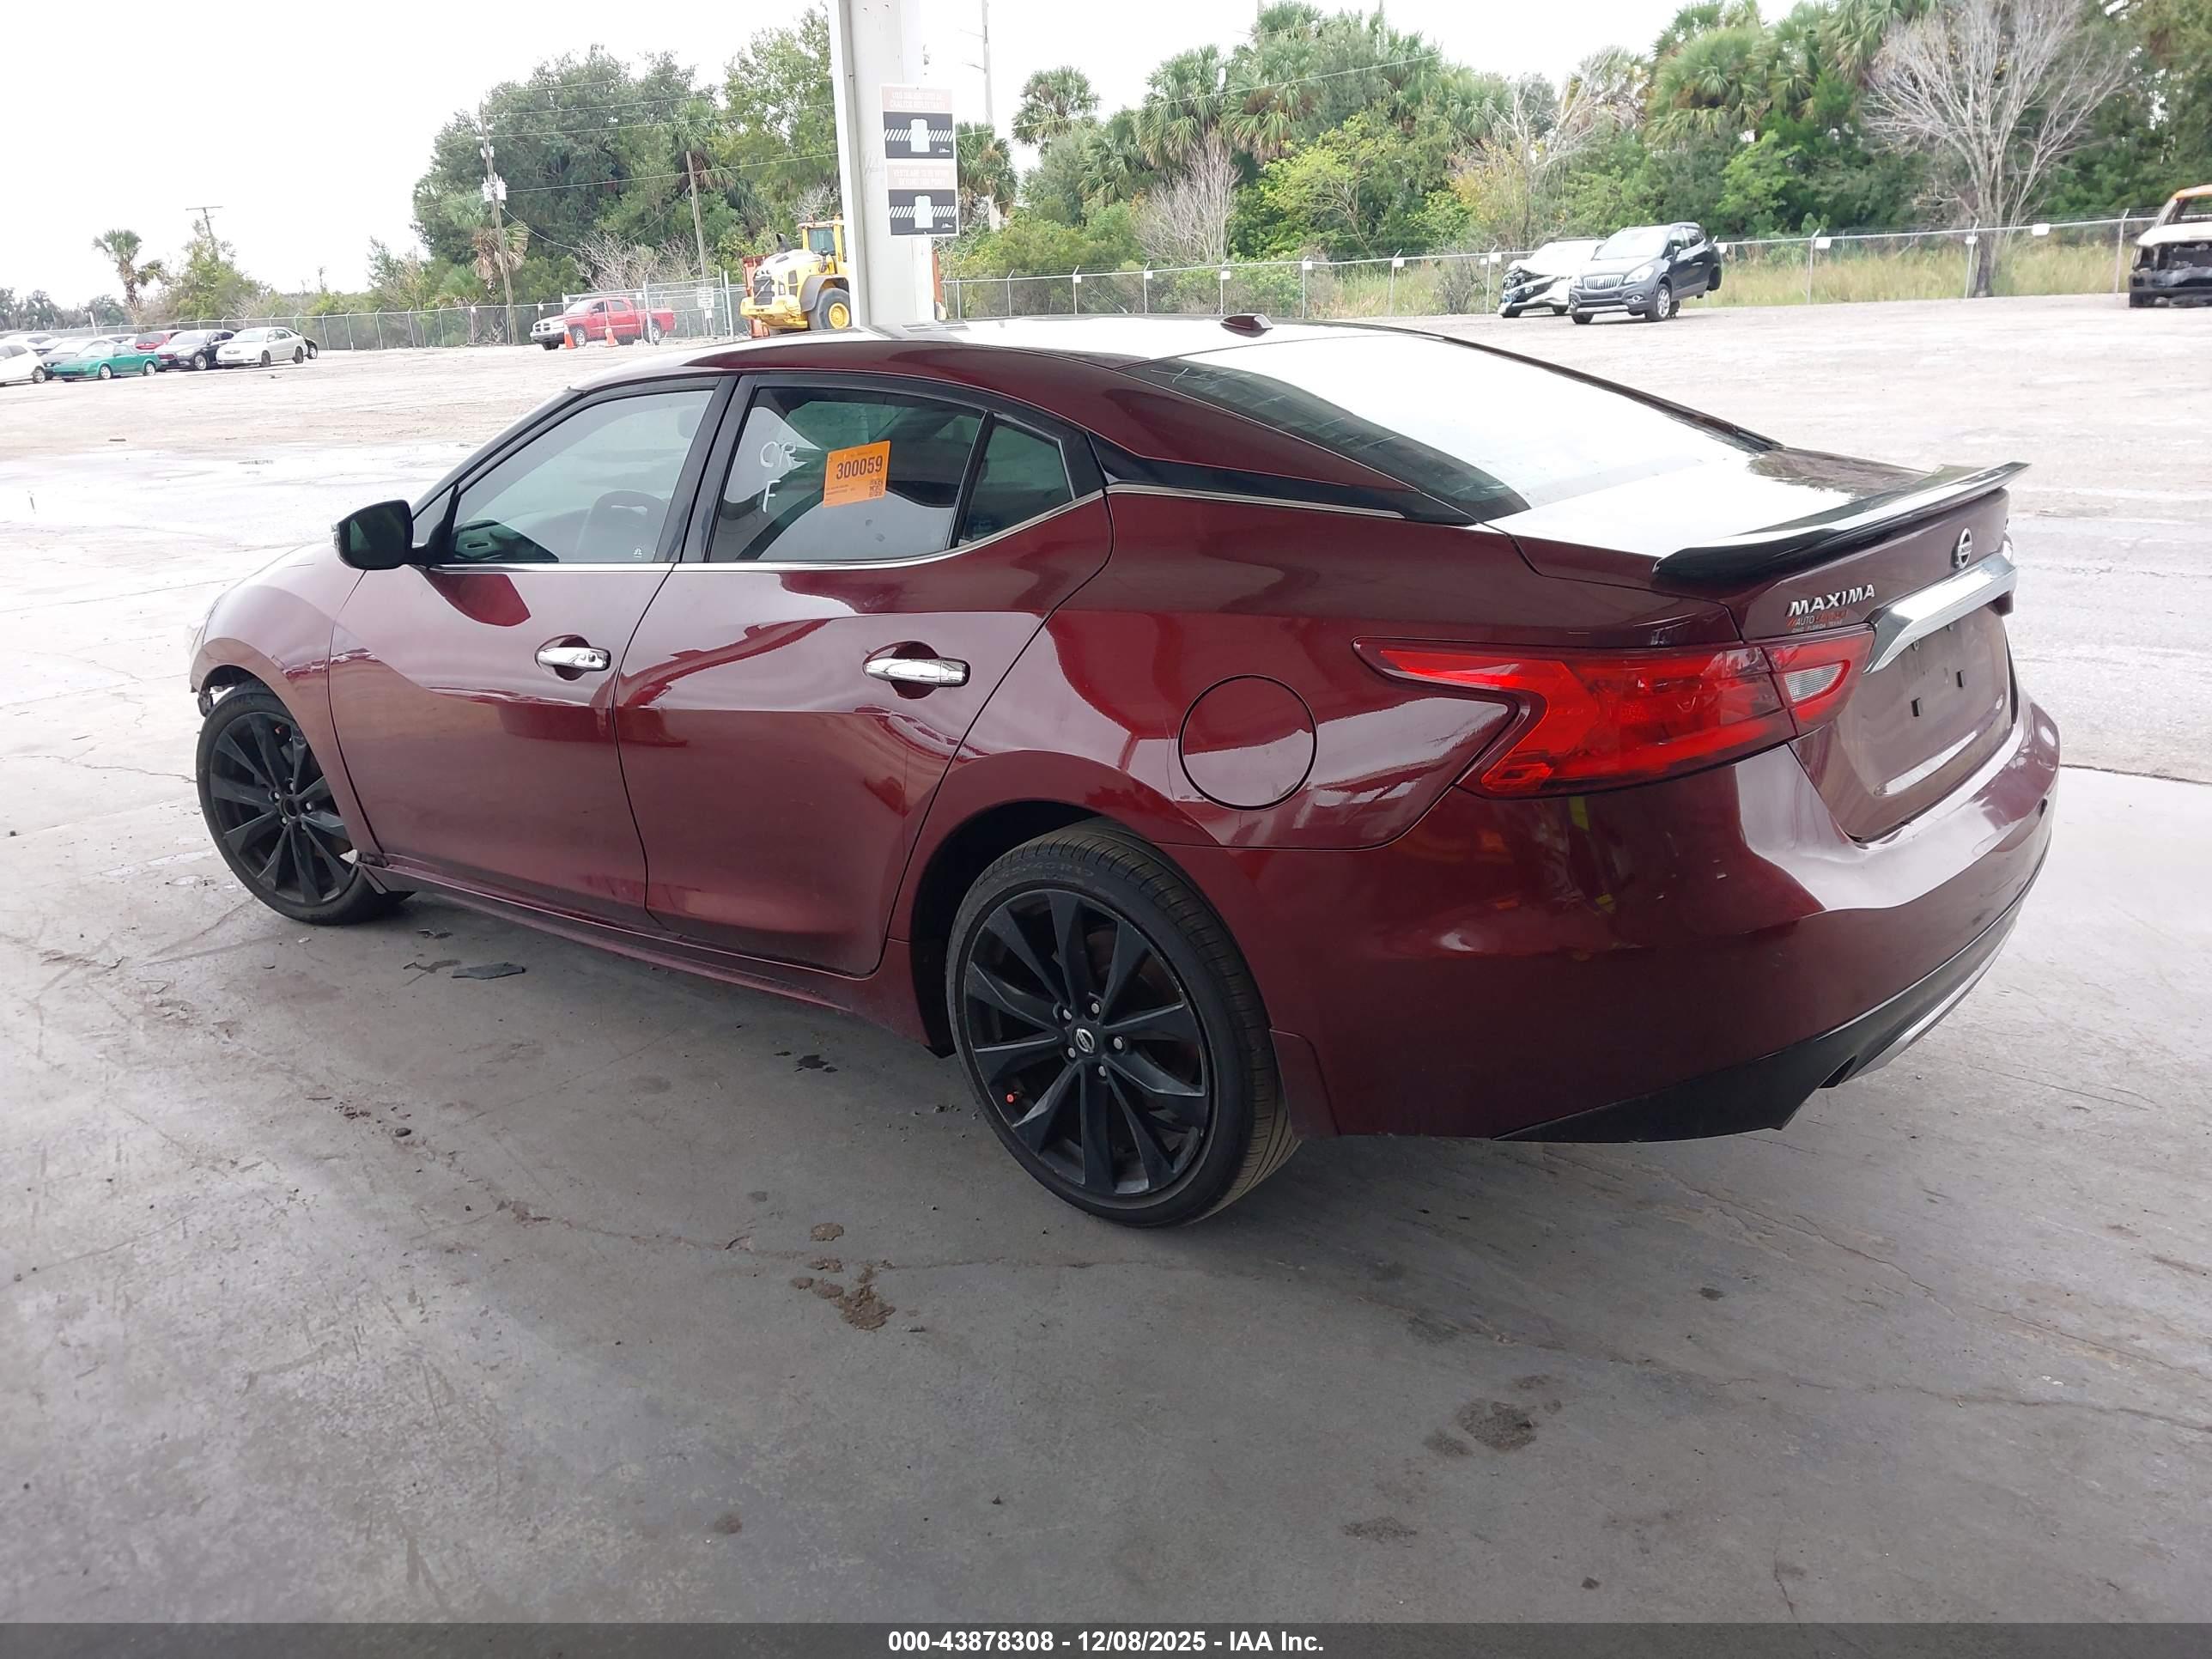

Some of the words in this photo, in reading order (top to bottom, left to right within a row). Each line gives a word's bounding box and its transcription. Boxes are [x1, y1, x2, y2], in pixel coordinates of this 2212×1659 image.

[760, 441, 797, 468] CR
[836, 456, 883, 479] 300059
[763, 479, 781, 513] F
[1789, 584, 1875, 617] MAXIMA
